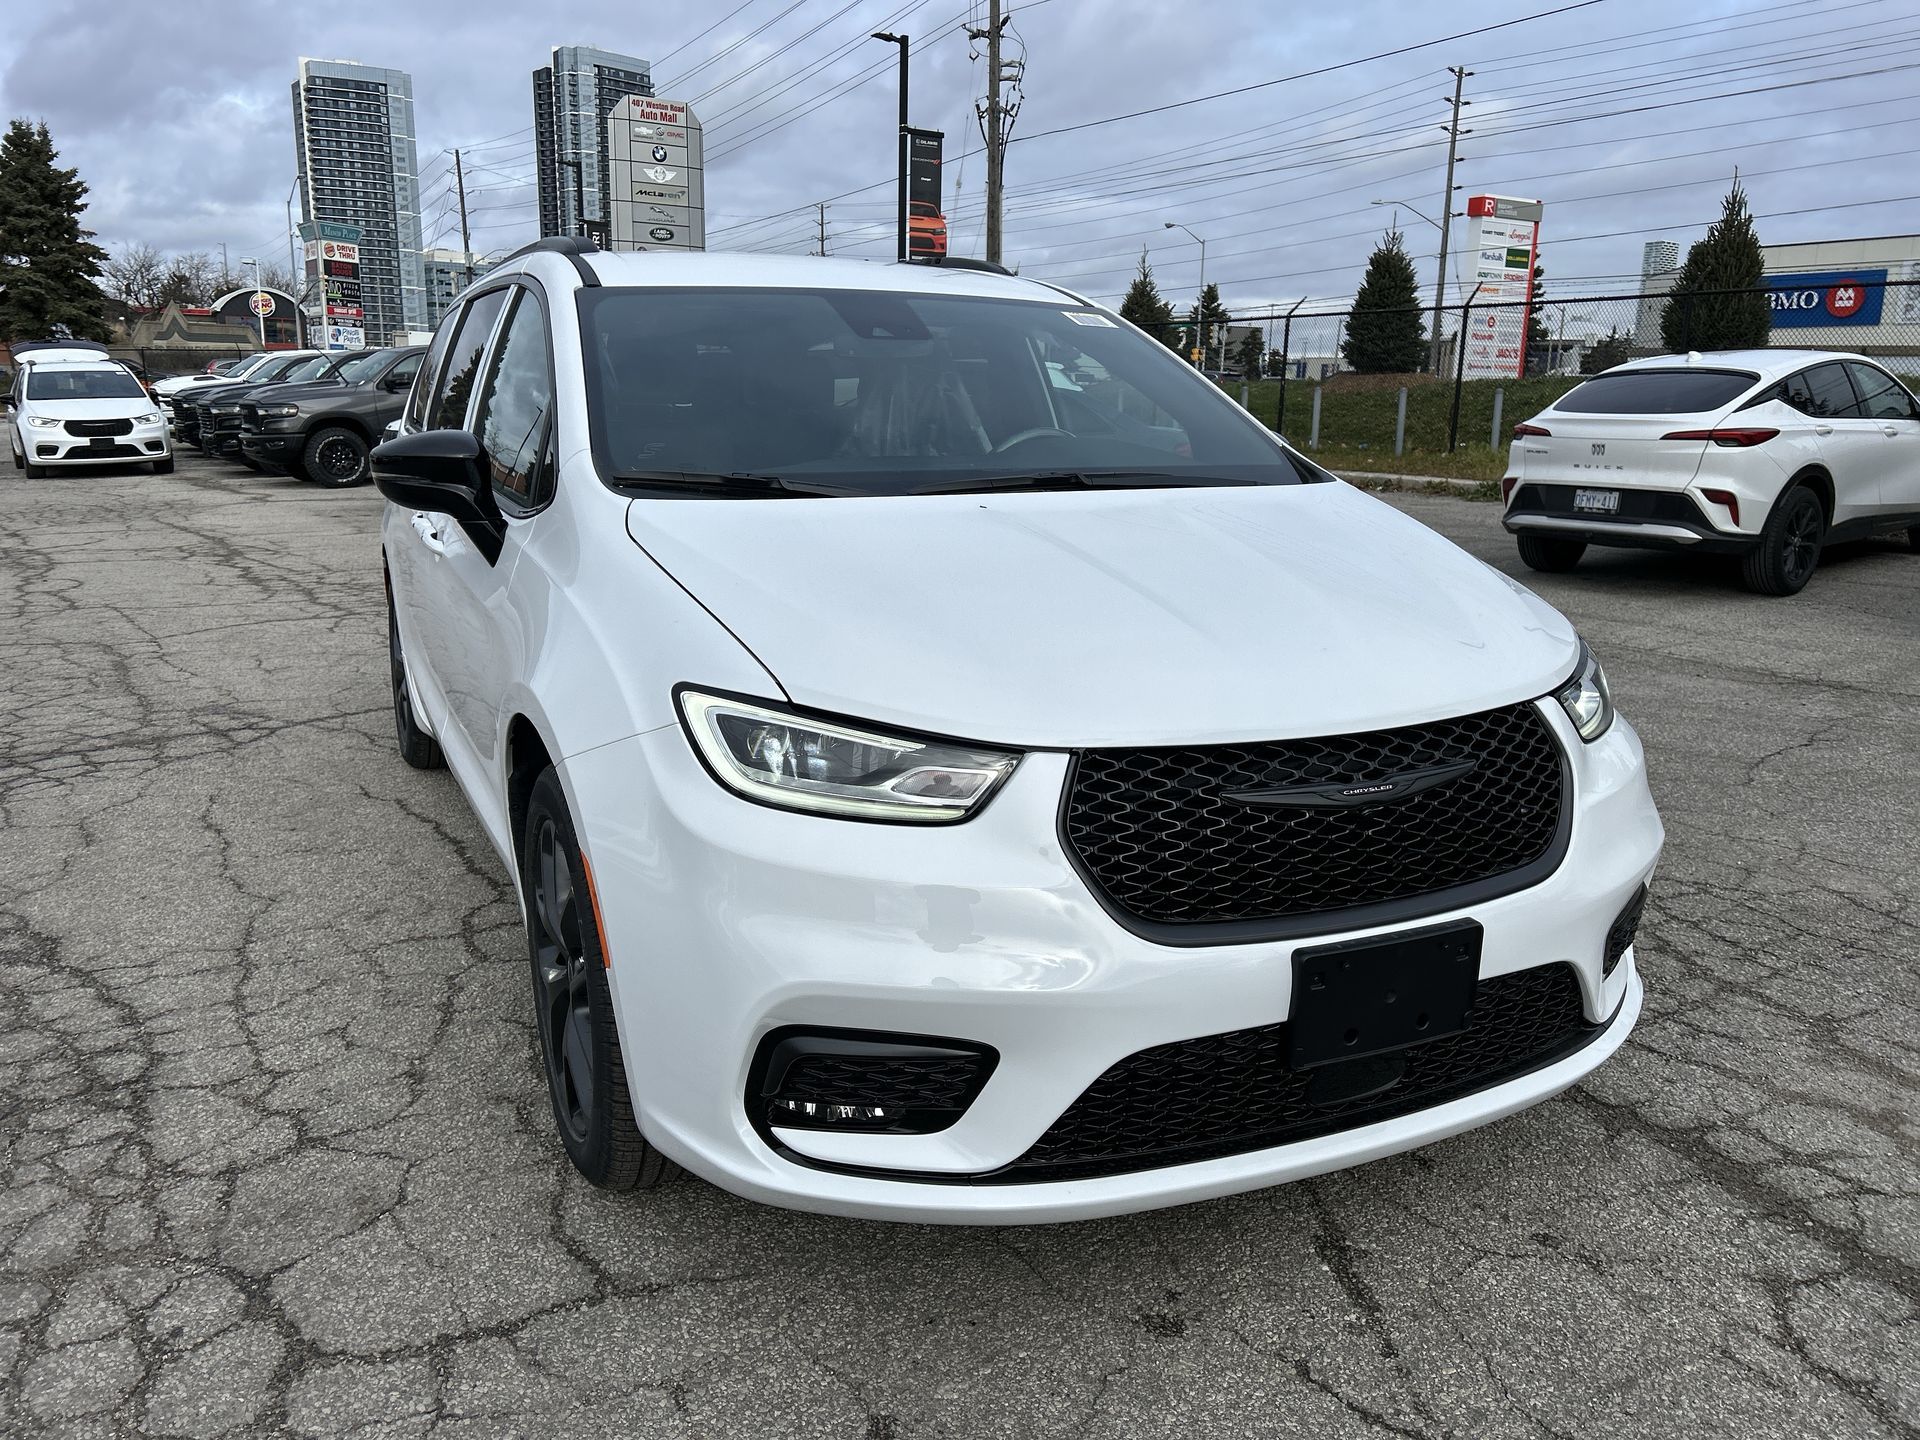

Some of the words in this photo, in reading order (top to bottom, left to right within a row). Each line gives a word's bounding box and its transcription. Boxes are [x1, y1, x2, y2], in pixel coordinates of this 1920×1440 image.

[631, 98, 643, 107] 407
[646, 100, 669, 111] Weston
[670, 104, 685, 113] Road
[640, 109, 658, 121] Auto
[660, 112, 677, 123] Mall
[666, 131, 685, 139] GMC
[635, 189, 680, 199] McLaren
[336, 244, 357, 254] DRIVE
[338, 251, 356, 260] THRU
[253, 302, 273, 310] KNG
[1343, 784, 1393, 795] CHRYSLER
